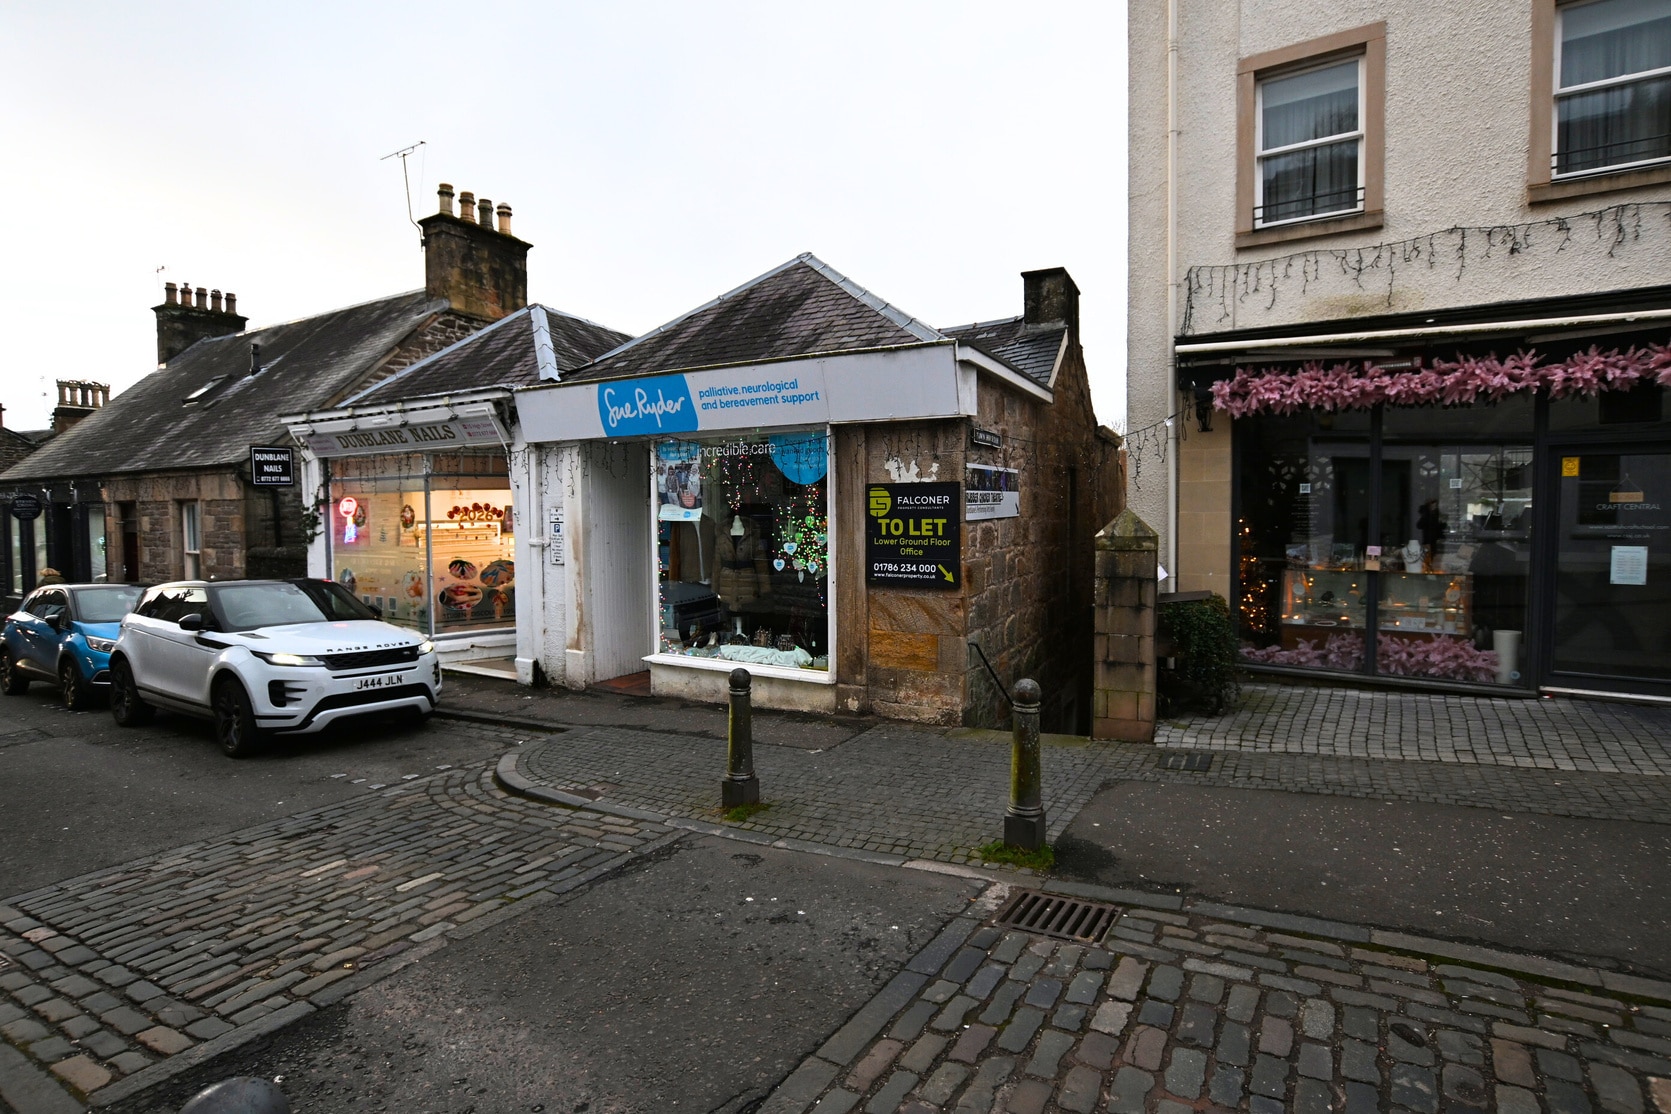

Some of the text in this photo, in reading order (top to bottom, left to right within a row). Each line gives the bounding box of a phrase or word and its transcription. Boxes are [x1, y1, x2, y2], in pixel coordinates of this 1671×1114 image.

[742, 378, 798, 395] neurological
[701, 391, 820, 410] and bereavement support
[604, 387, 685, 428] Sue Ryder
[335, 429, 408, 449] DUNBLANE
[408, 425, 456, 442] NAILS
[751, 443, 776, 455] care
[254, 453, 290, 461] DUNBLANE
[897, 495, 950, 505] FALCONER
[1595, 503, 1661, 511] CRAFT CENTRAL
[460, 510, 494, 521] 2026
[877, 518, 947, 536] TO LET
[874, 537, 951, 546] Lower Ground Floor
[900, 548, 923, 556] Office
[873, 563, 936, 573] 01786 234 000
[326, 645, 368, 653] RANGE
[356, 675, 403, 690] J444 JLN
